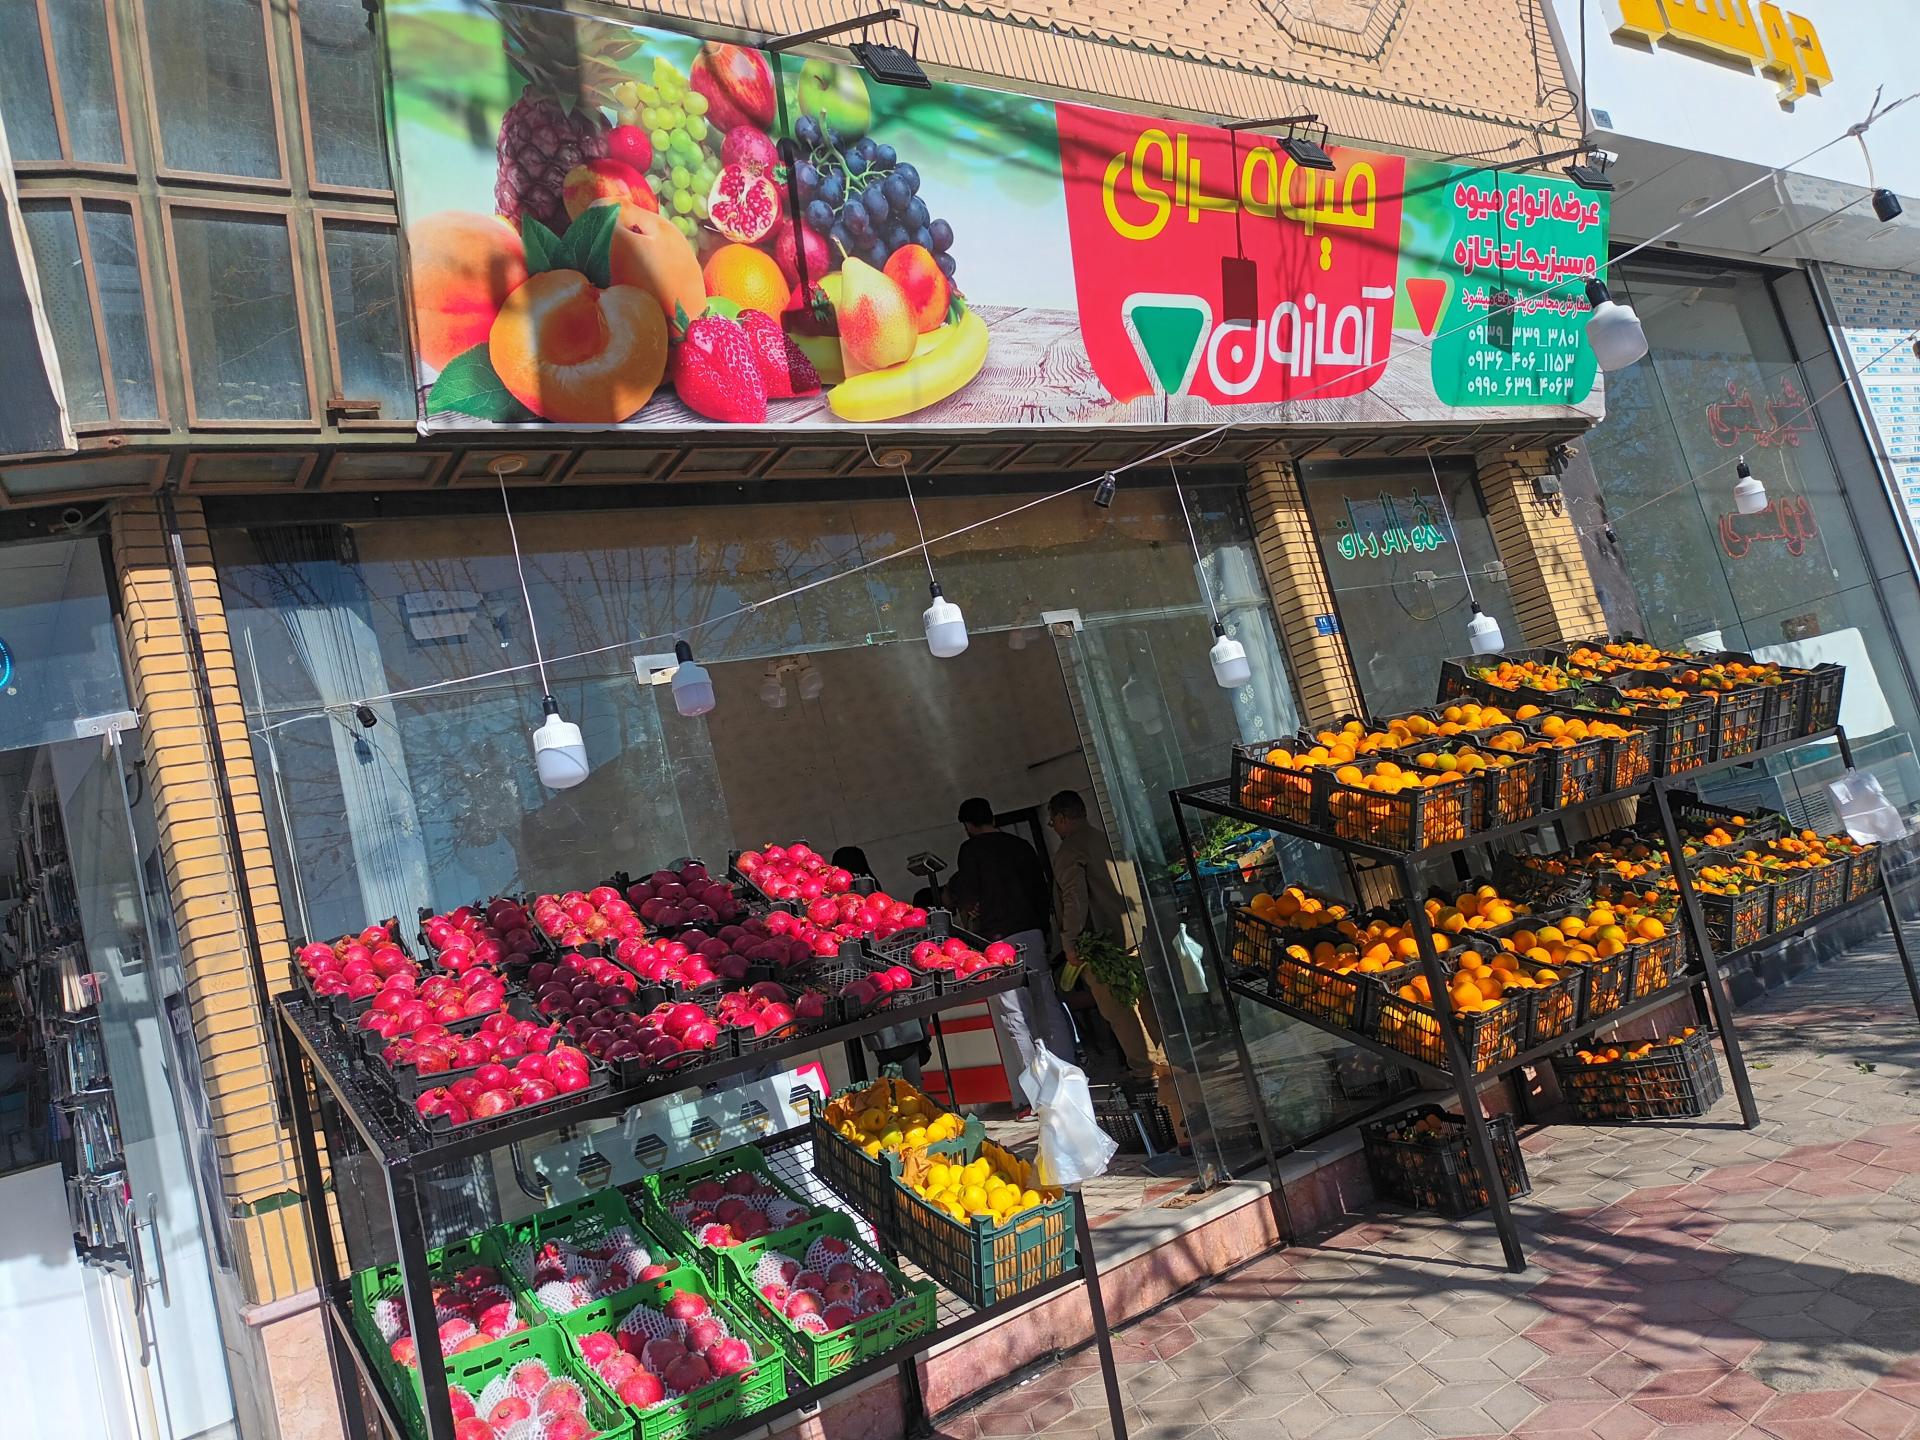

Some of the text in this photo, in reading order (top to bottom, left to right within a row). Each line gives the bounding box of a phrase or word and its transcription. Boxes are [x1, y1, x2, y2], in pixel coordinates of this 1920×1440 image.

[1454, 181, 1600, 233] عرضه انواع میوه
[1453, 235, 1597, 284] و سبزیجات تازه
[1462, 286, 1495, 313] میشود
[1527, 291, 1559, 316] مجالس
[1206, 284, 1395, 396] آمازون
